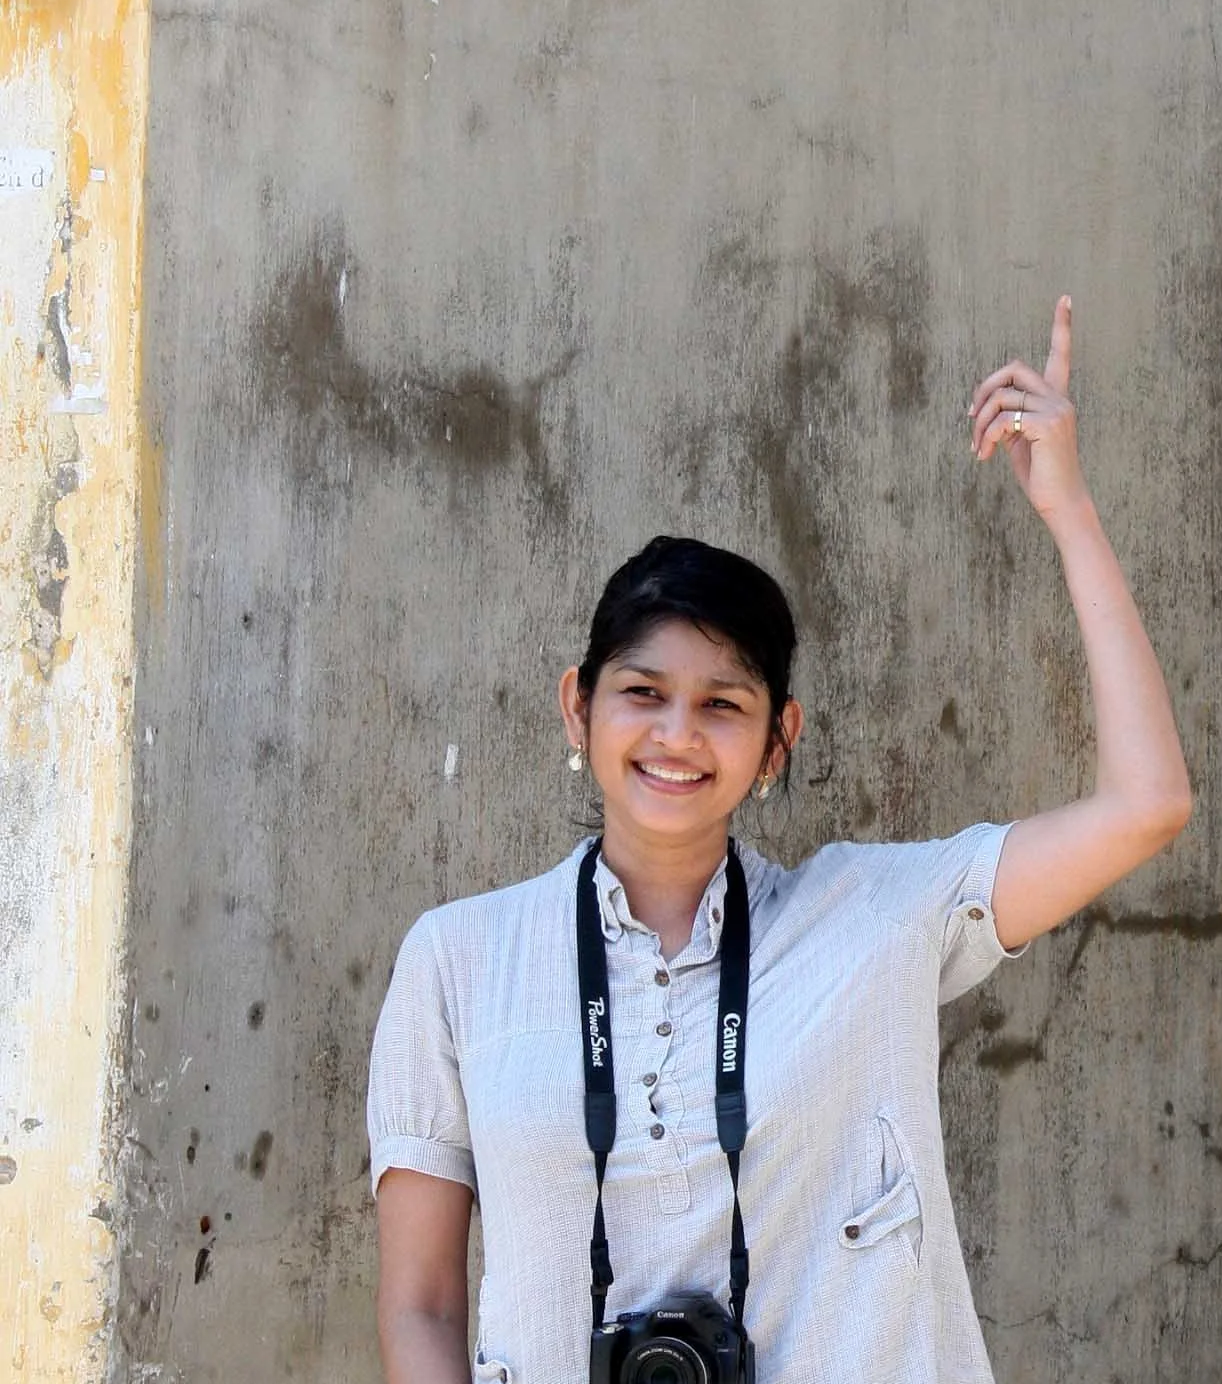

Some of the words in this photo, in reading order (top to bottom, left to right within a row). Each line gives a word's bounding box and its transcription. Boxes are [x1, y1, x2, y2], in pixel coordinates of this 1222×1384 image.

[588, 997, 608, 1067] PowerShot
[722, 1013, 741, 1072] Canon
[656, 1310, 685, 1320] Canon
